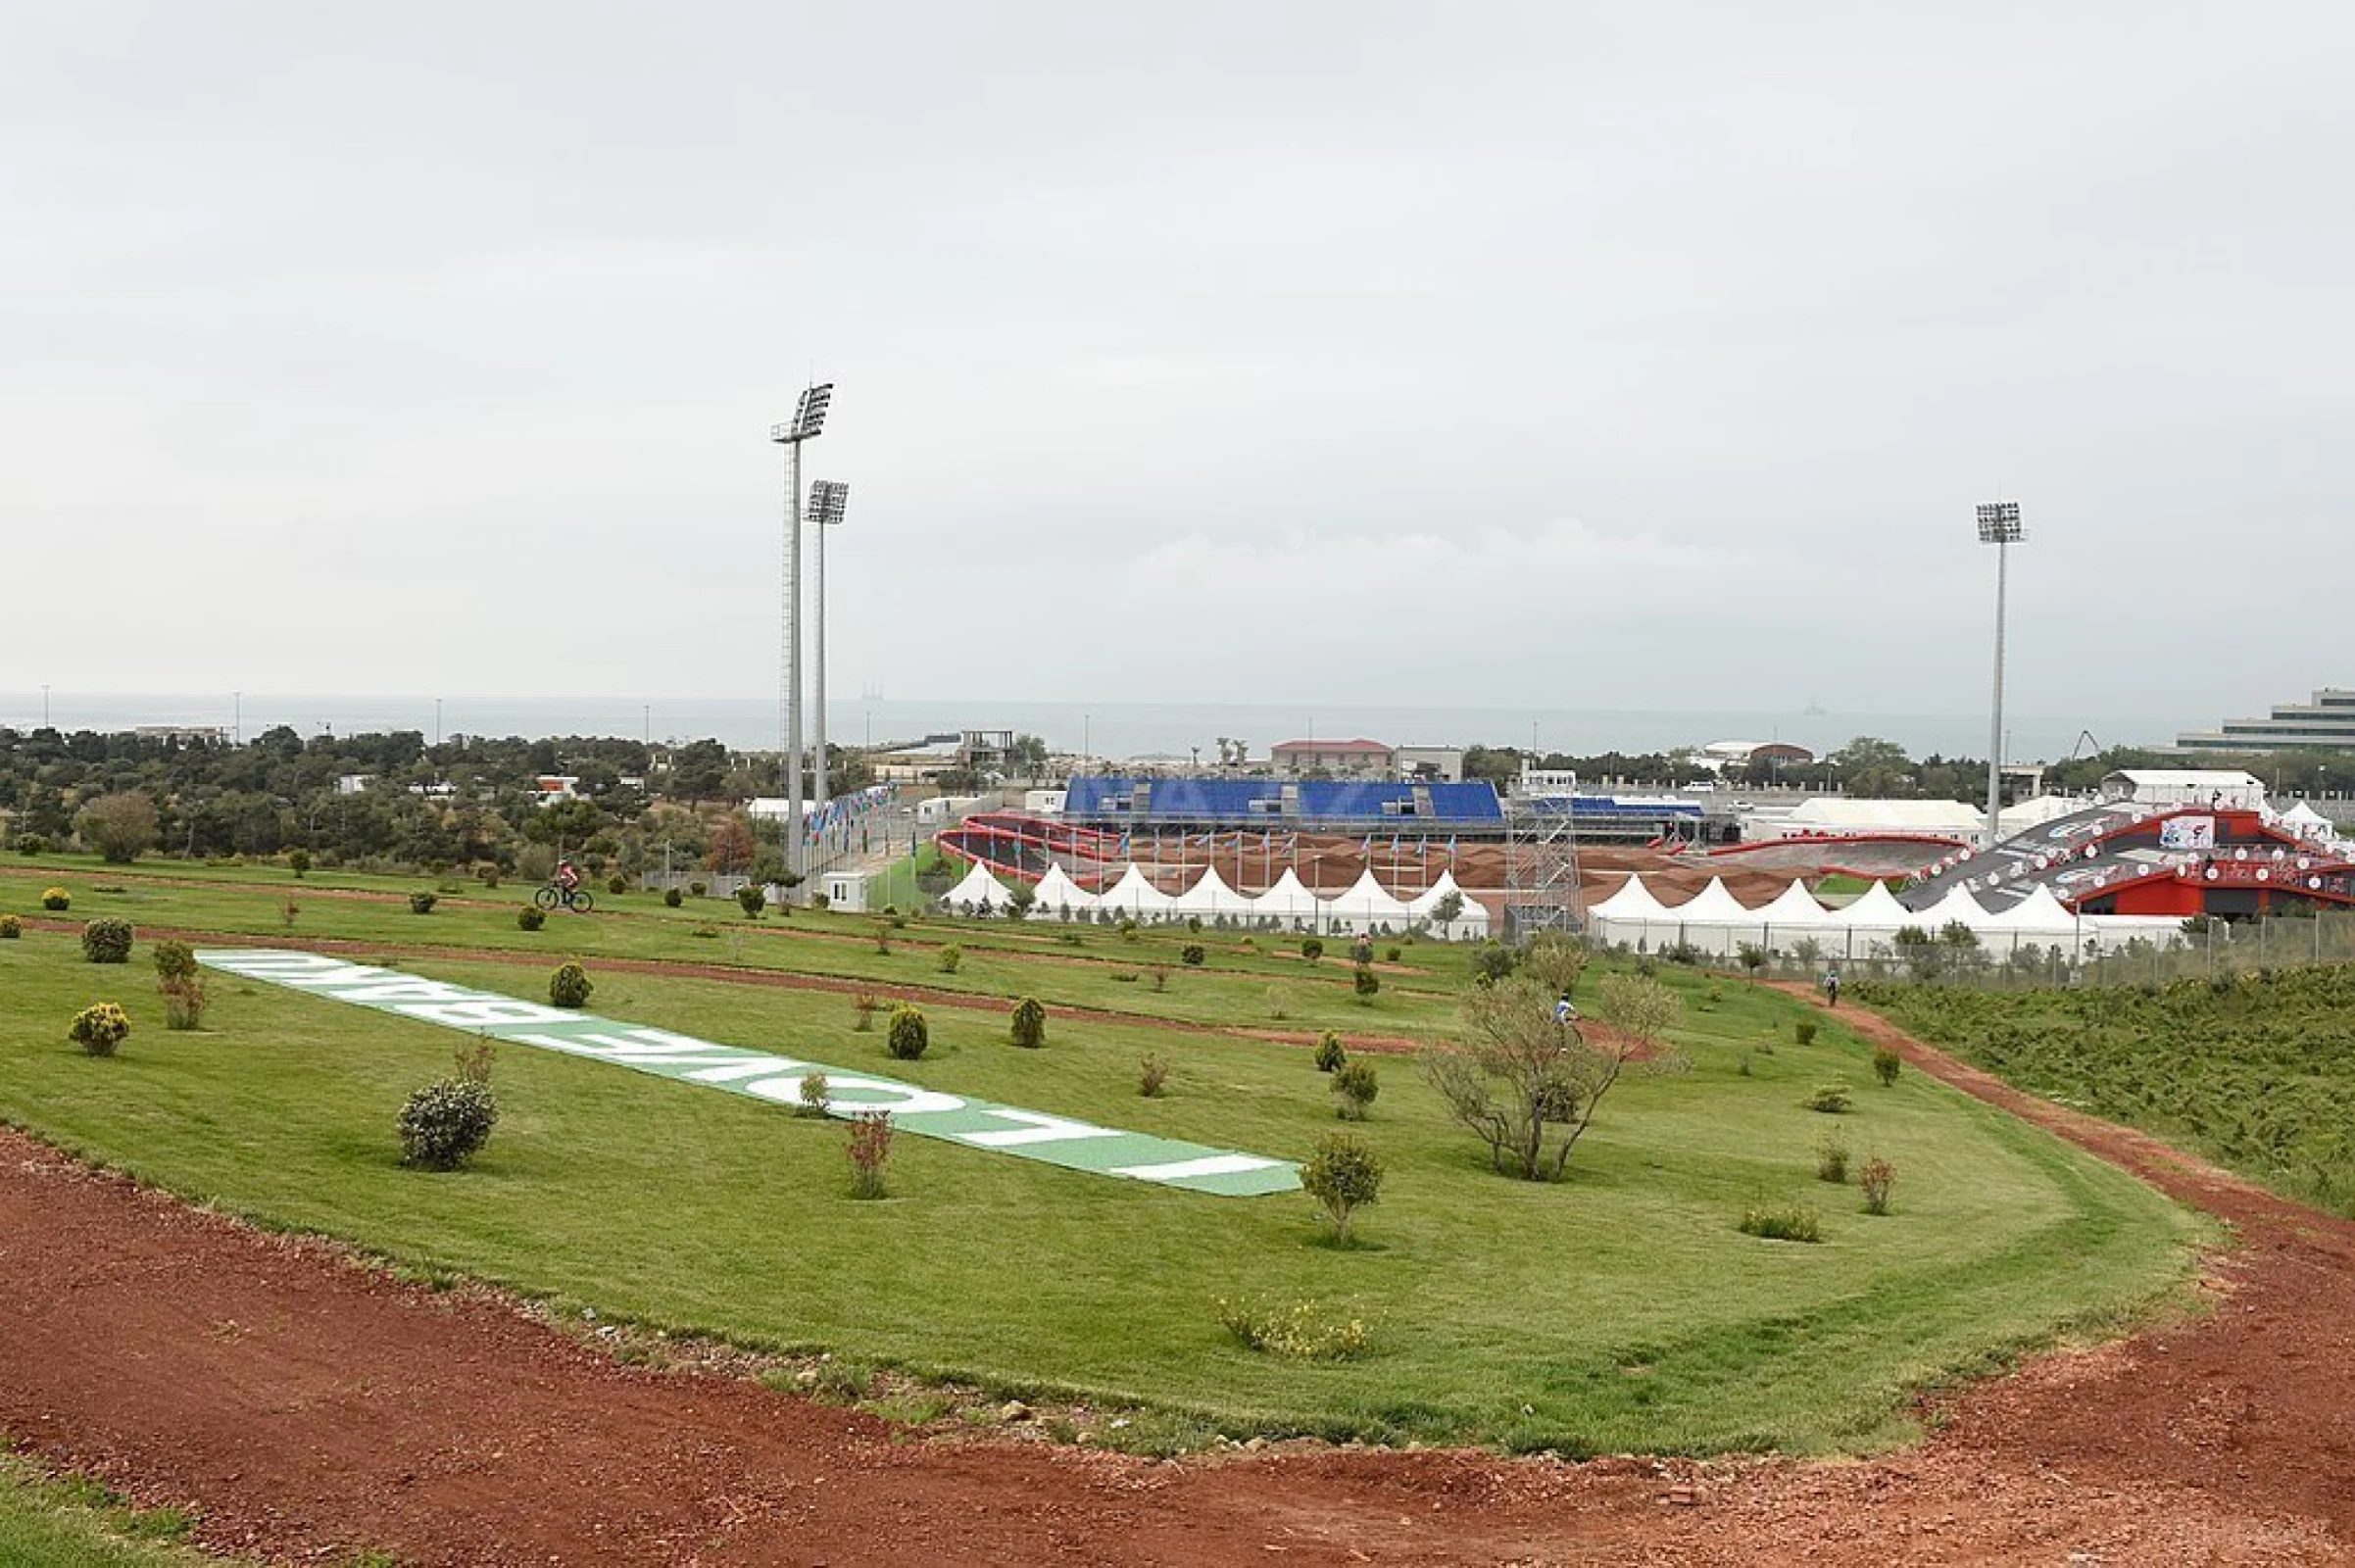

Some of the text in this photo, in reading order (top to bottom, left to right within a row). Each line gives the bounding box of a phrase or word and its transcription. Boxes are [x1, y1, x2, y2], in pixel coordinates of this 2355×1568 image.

[192, 955, 1284, 1180] I LOVE BAKU
